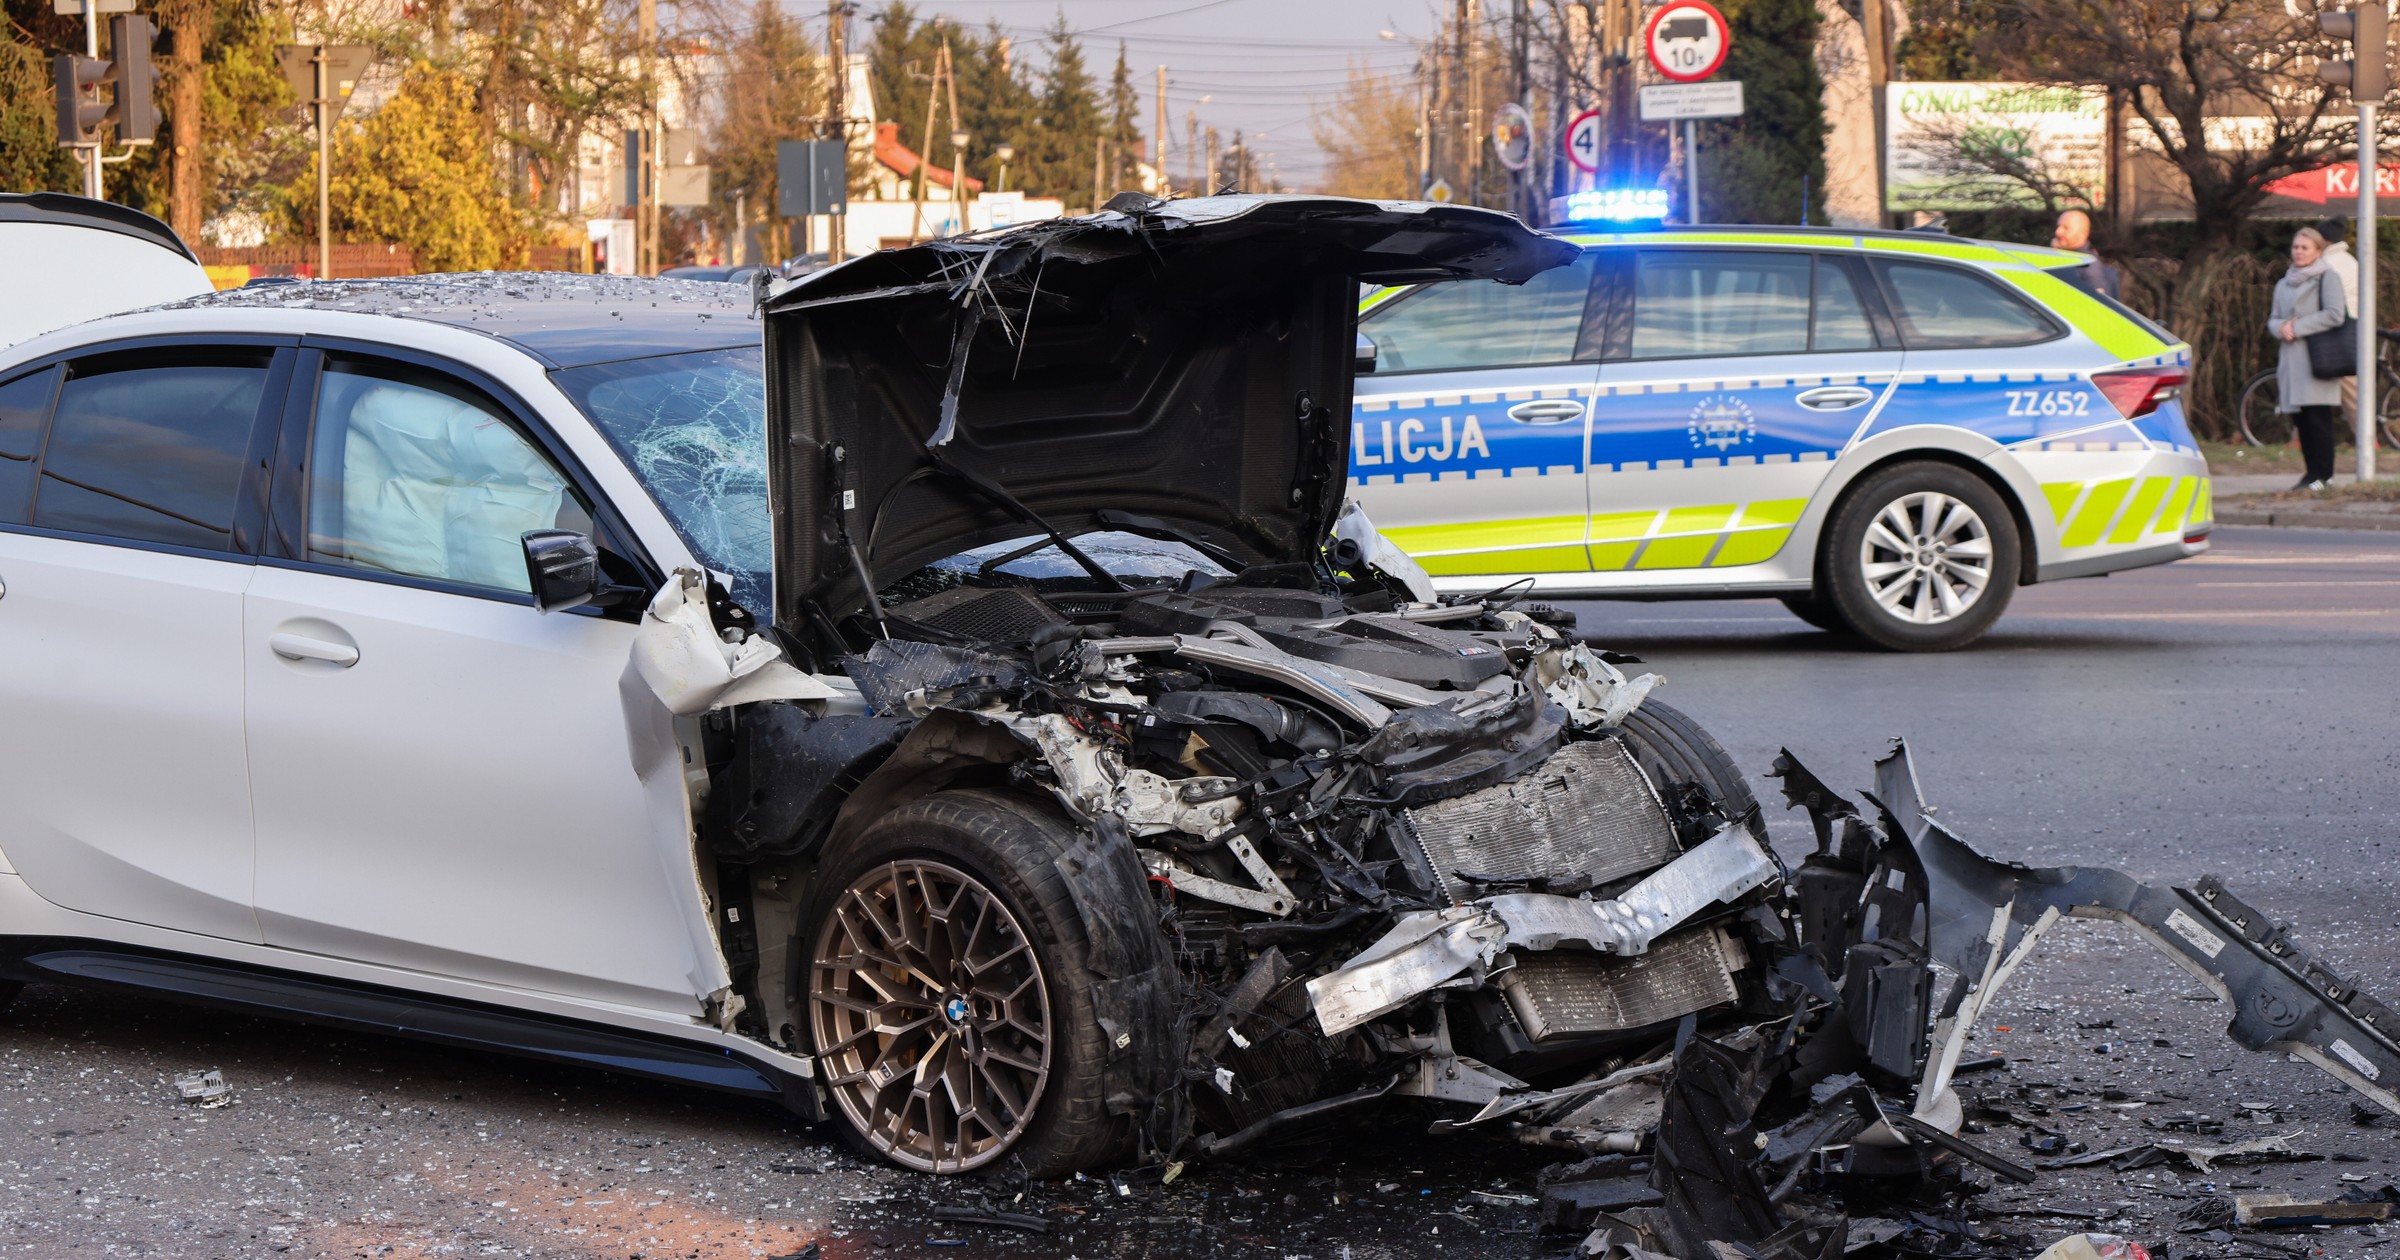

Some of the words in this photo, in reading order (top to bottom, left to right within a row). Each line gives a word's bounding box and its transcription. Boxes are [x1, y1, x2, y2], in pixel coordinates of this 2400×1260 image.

[1574, 126, 1593, 154] 4
[2326, 168, 2400, 193] KR
[2005, 391, 2090, 416] ZZ652
[1354, 415, 1491, 466] LICJA
